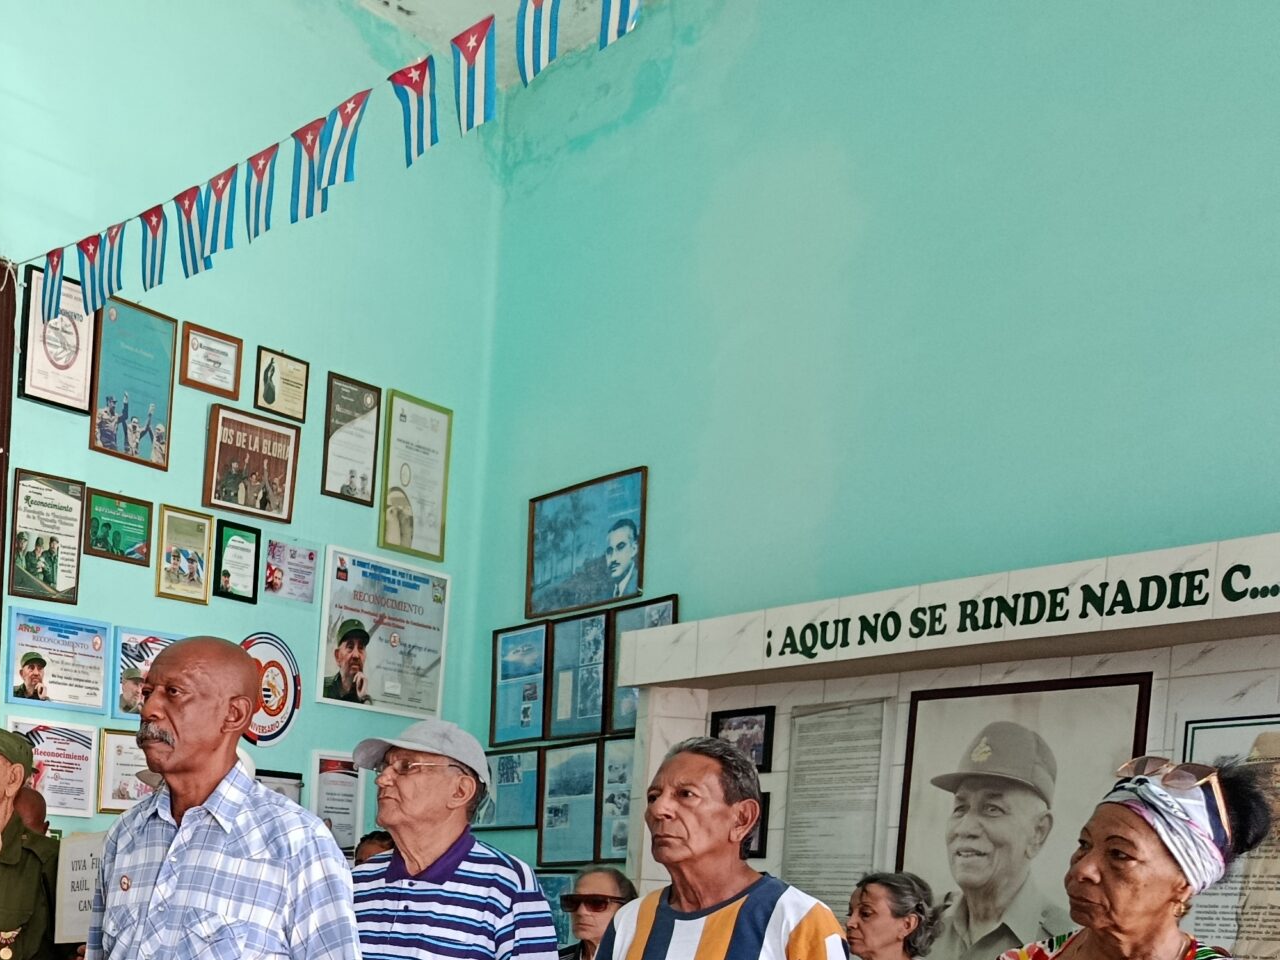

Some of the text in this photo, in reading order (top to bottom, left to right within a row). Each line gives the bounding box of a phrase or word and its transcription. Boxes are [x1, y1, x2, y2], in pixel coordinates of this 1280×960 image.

[236, 431, 247, 448] DE
[248, 434, 259, 452] LA
[262, 439, 290, 460] GLORIA
[24, 495, 73, 512] Reconocimiento
[353, 590, 424, 616] RECONOCIMIENTO
[858, 611, 902, 646] NO
[909, 603, 947, 639] SE
[957, 587, 1069, 633] RINDE
[1079, 568, 1210, 619] NADIE
[34, 748, 89, 762] Reconocimiento
[72, 859, 87, 872] VIVA
[78, 900, 92, 911] CAN
